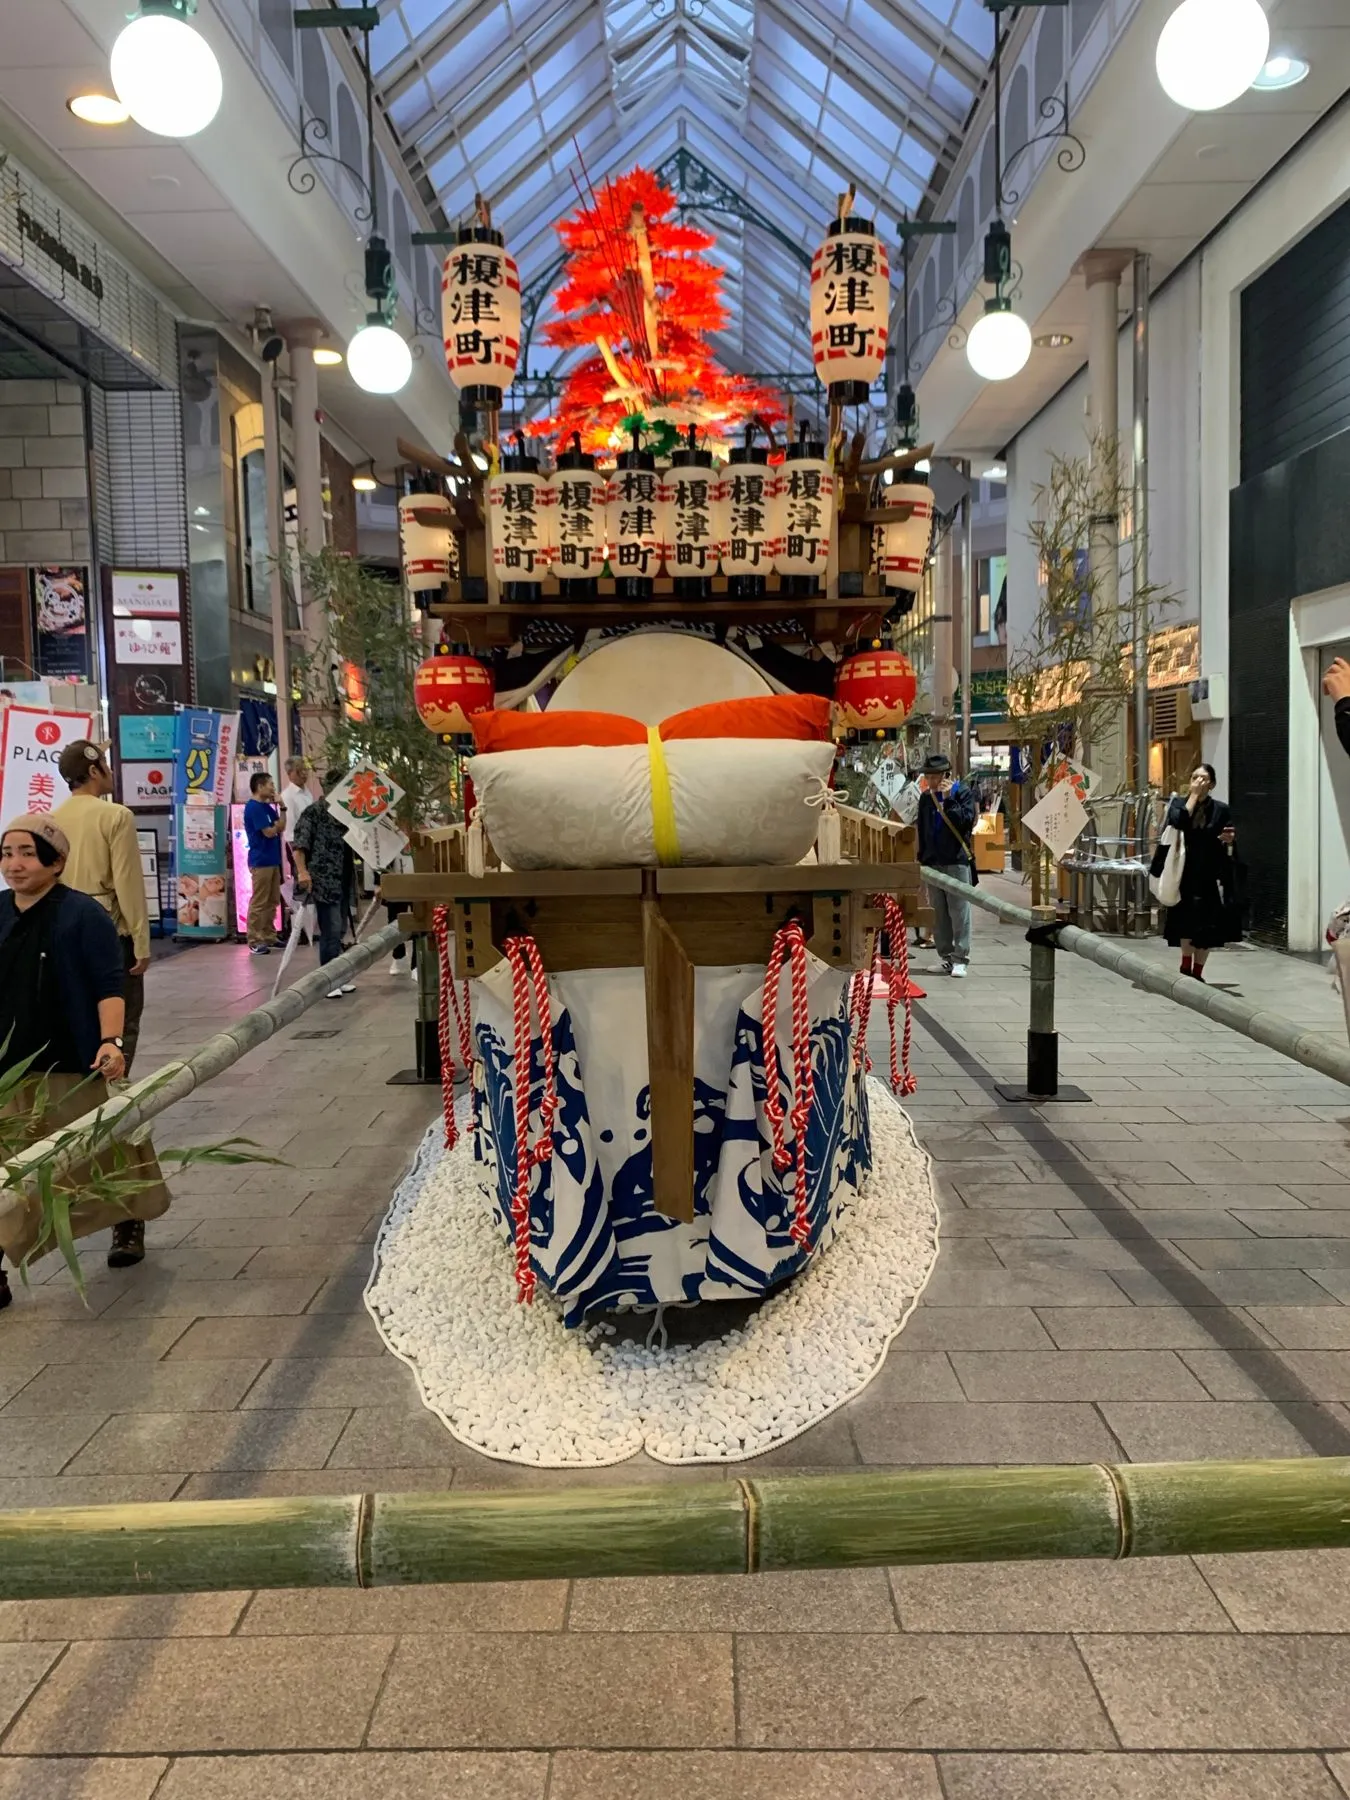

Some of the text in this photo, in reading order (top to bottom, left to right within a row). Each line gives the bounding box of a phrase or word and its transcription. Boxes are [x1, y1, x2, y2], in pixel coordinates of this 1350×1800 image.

[451, 253, 500, 364] 榎津町
[824, 243, 875, 357] 榎津町
[501, 483, 537, 573] 榎津町
[558, 481, 594, 570] 榎津町
[618, 472, 656, 574] 榎津町
[674, 479, 710, 569] 榎津町
[730, 475, 765, 566] 榎津町
[786, 469, 822, 564] 榎津町
